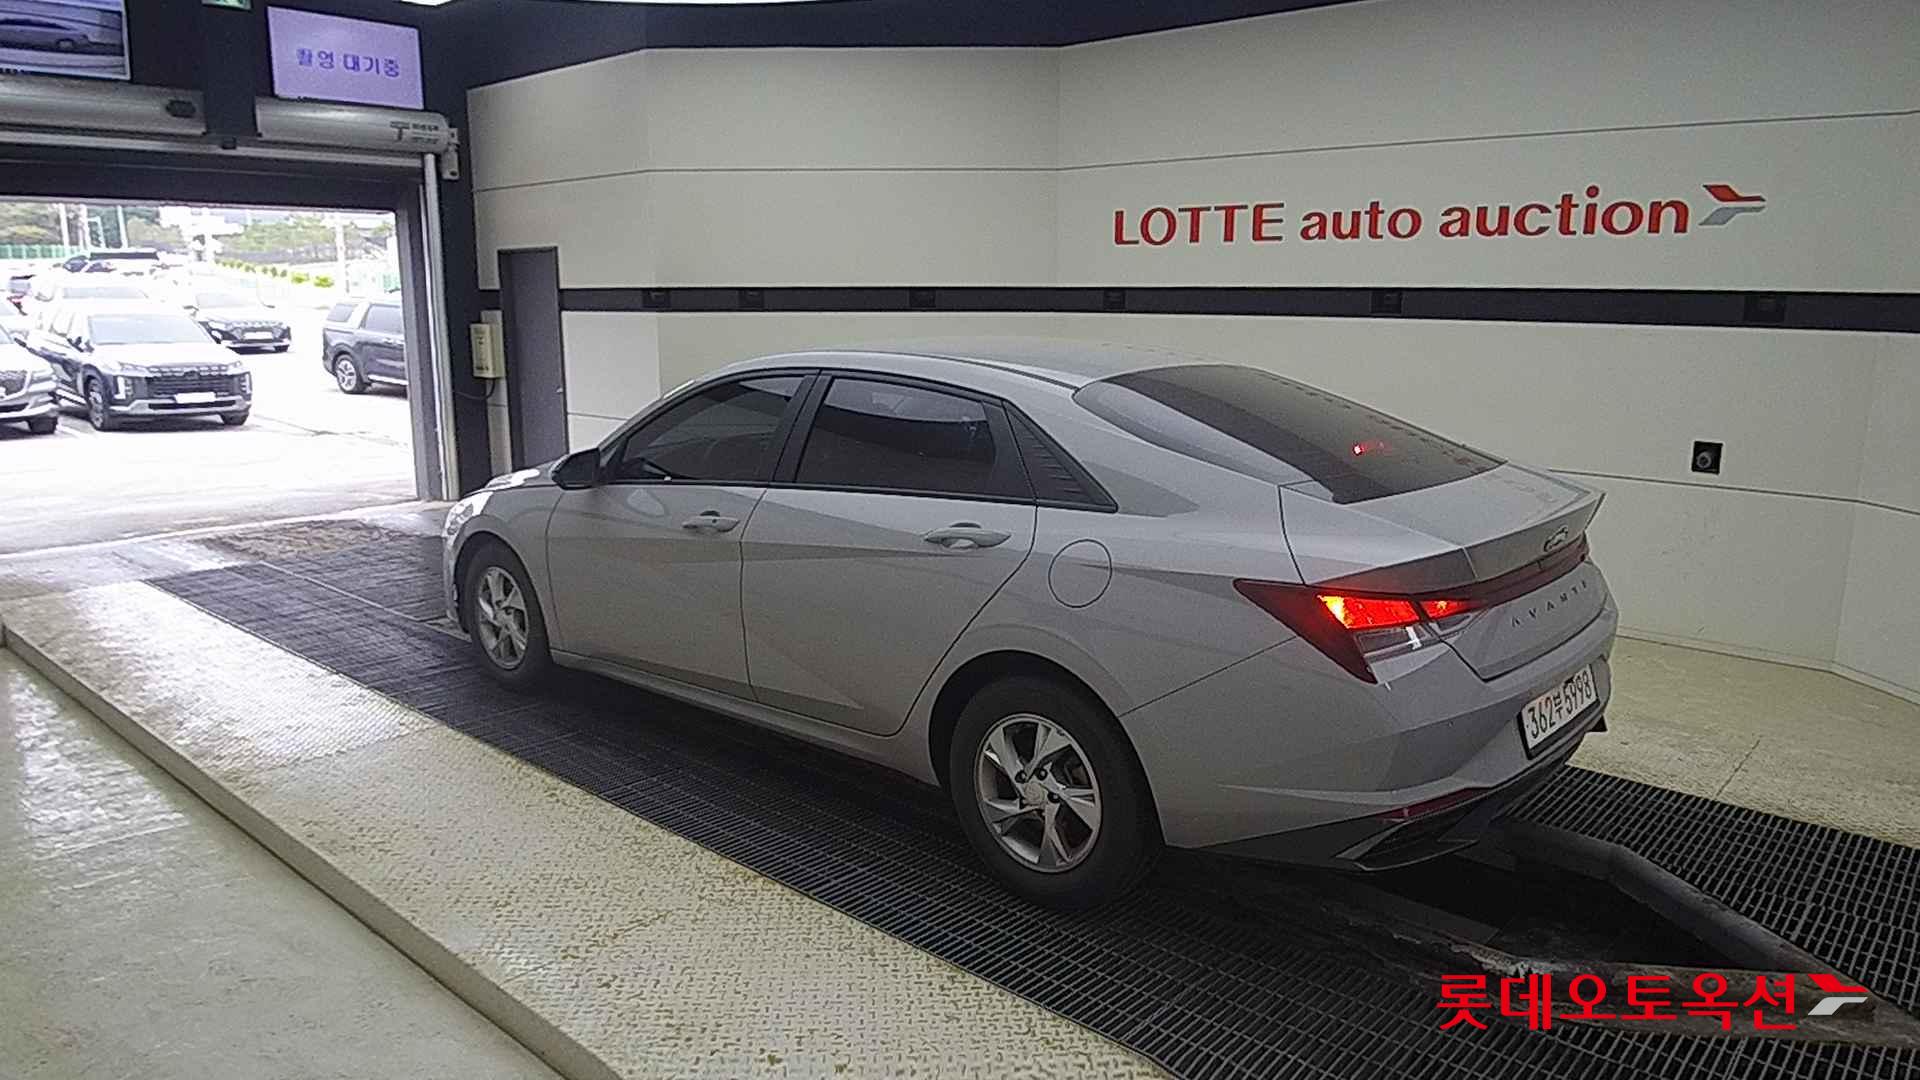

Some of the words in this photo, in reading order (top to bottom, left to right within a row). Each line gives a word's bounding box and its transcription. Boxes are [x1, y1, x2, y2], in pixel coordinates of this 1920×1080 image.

[342, 53, 400, 78] 대기중
[1115, 203, 1285, 245] LOTTE
[1301, 200, 1422, 241] auto
[1440, 185, 1689, 238] auction
